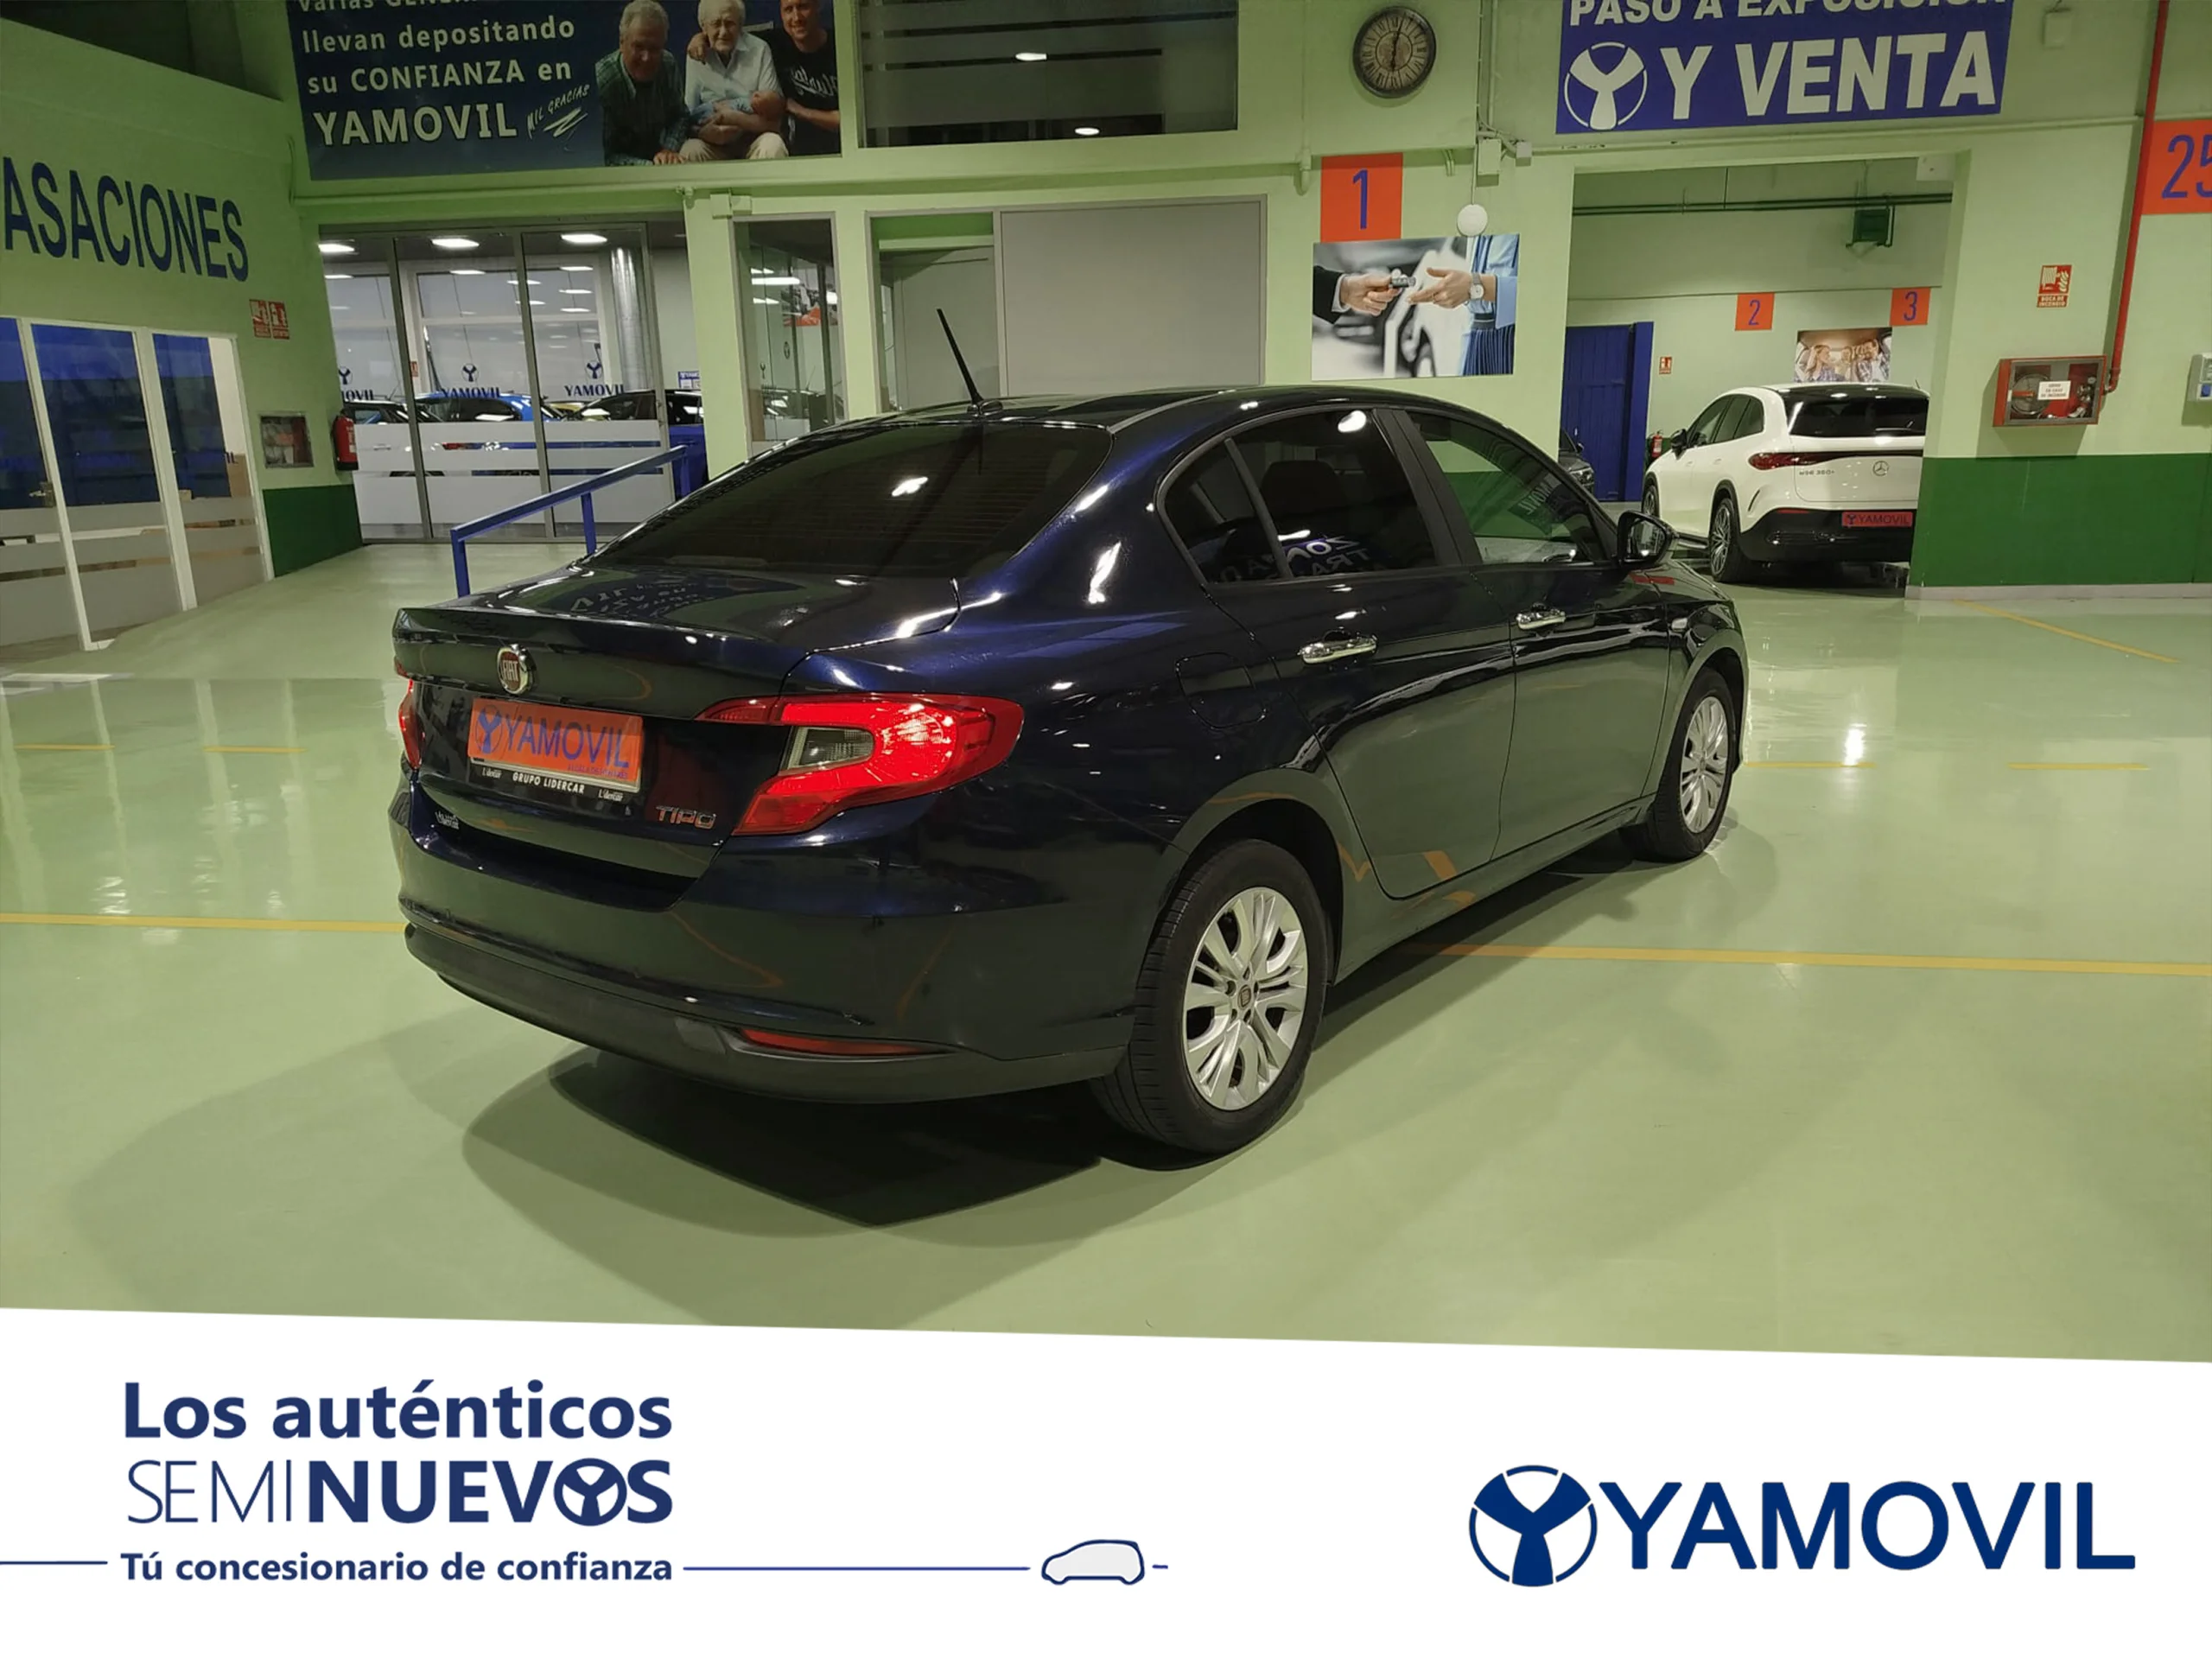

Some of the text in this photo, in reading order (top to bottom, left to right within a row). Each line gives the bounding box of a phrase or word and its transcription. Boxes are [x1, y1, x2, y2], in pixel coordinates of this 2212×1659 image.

[1569, 0, 1680, 26] PASO
[1694, 0, 1725, 19] A
[302, 16, 575, 53] llevan depositando
[308, 59, 571, 94] su CONFIANZA en
[1660, 30, 1998, 120] Y VENTA
[313, 102, 517, 145] YAMOVIL
[526, 85, 589, 139] MIL GRACIAS
[2162, 133, 2212, 199] 25
[1352, 169, 1370, 230] 1
[3, 156, 249, 282] ASACIONES
[1747, 299, 1761, 326] 2
[1904, 291, 1918, 321] 3
[1859, 514, 1910, 524] YAMOVIL
[500, 659, 519, 682] FIAT
[505, 714, 630, 768] YAMOVIL
[512, 772, 585, 794] GRUPO LIDERCAR
[656, 805, 717, 830] TIPO
